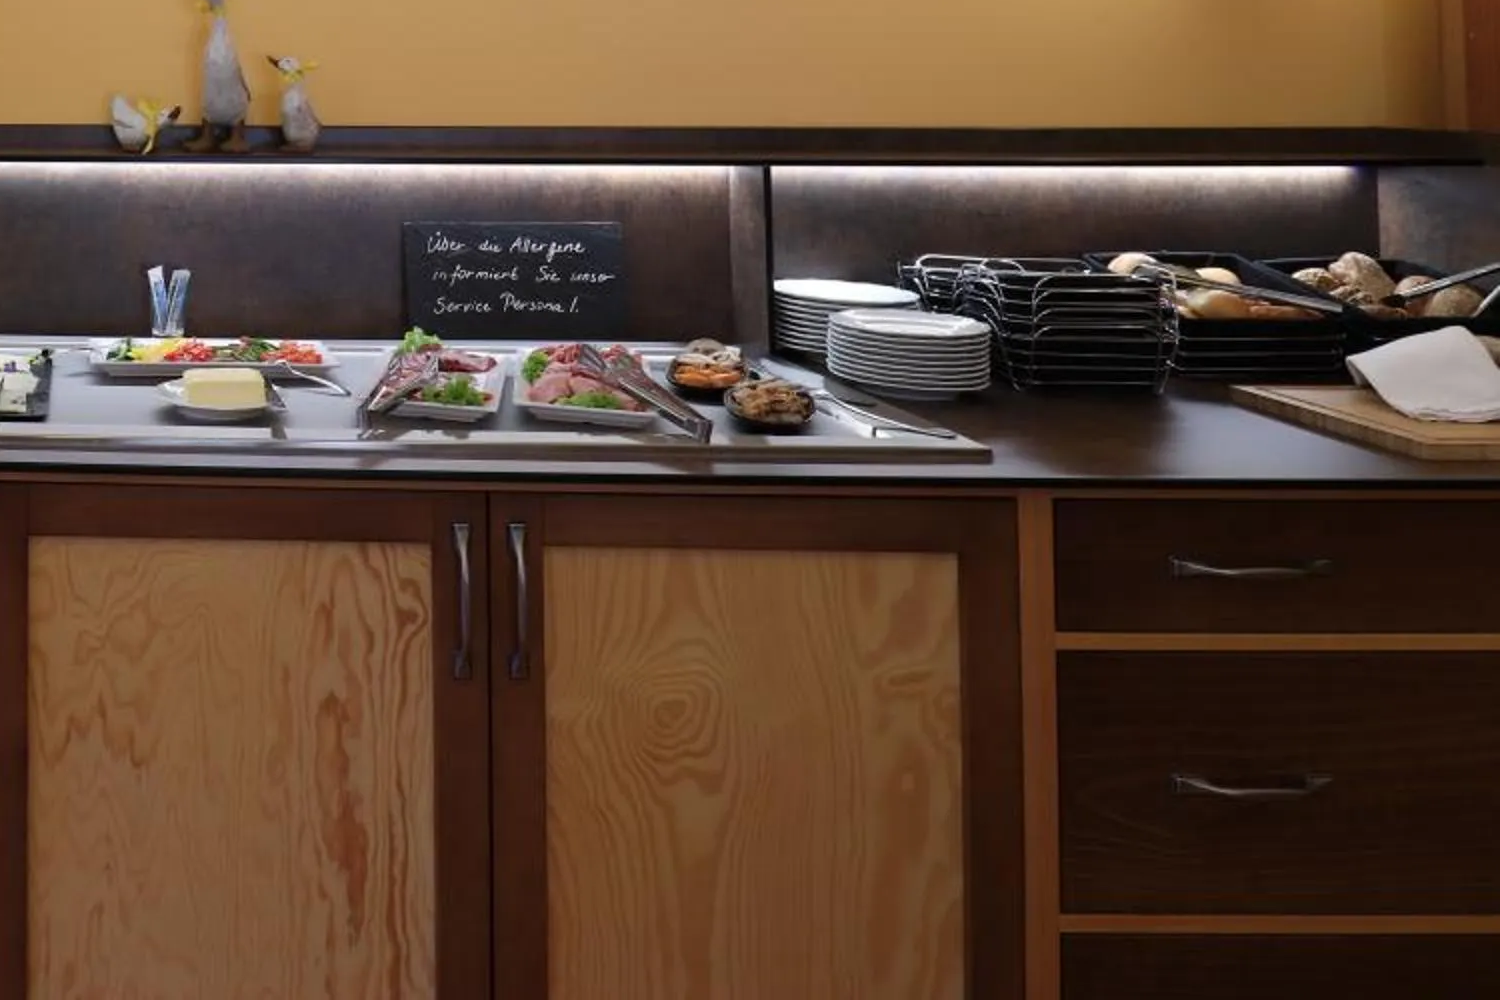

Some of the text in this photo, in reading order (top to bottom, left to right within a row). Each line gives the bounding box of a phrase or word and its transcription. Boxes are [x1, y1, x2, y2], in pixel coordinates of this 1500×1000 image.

[478, 238, 501, 253] die
[509, 236, 585, 262] Allergene
[432, 264, 616, 287] informiert Sie unser
[433, 296, 492, 315] Service
